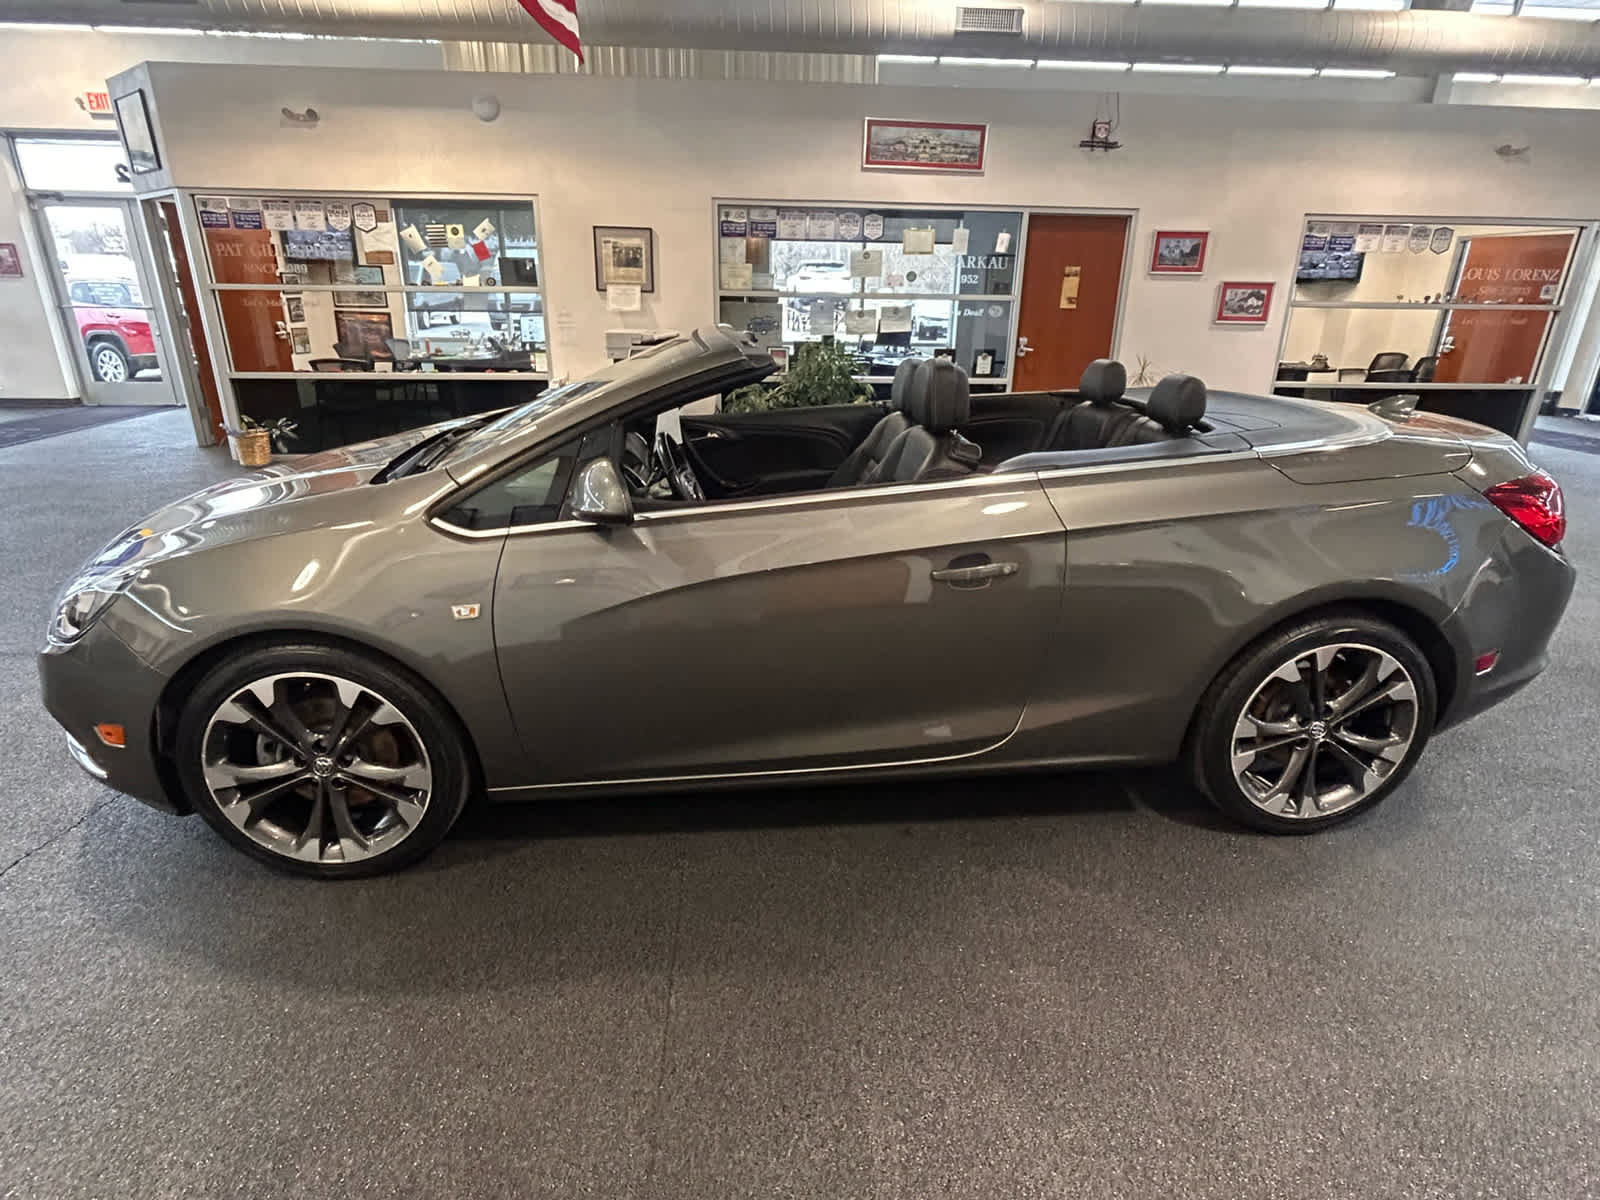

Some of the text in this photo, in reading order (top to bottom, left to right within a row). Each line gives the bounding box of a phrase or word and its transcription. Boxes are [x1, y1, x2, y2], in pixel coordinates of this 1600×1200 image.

[87, 92, 110, 110] EXIT
[215, 243, 243, 257] PAT
[955, 255, 1009, 270] ARKAU
[961, 274, 979, 285] 952
[1503, 267, 1560, 281] LORENZ
